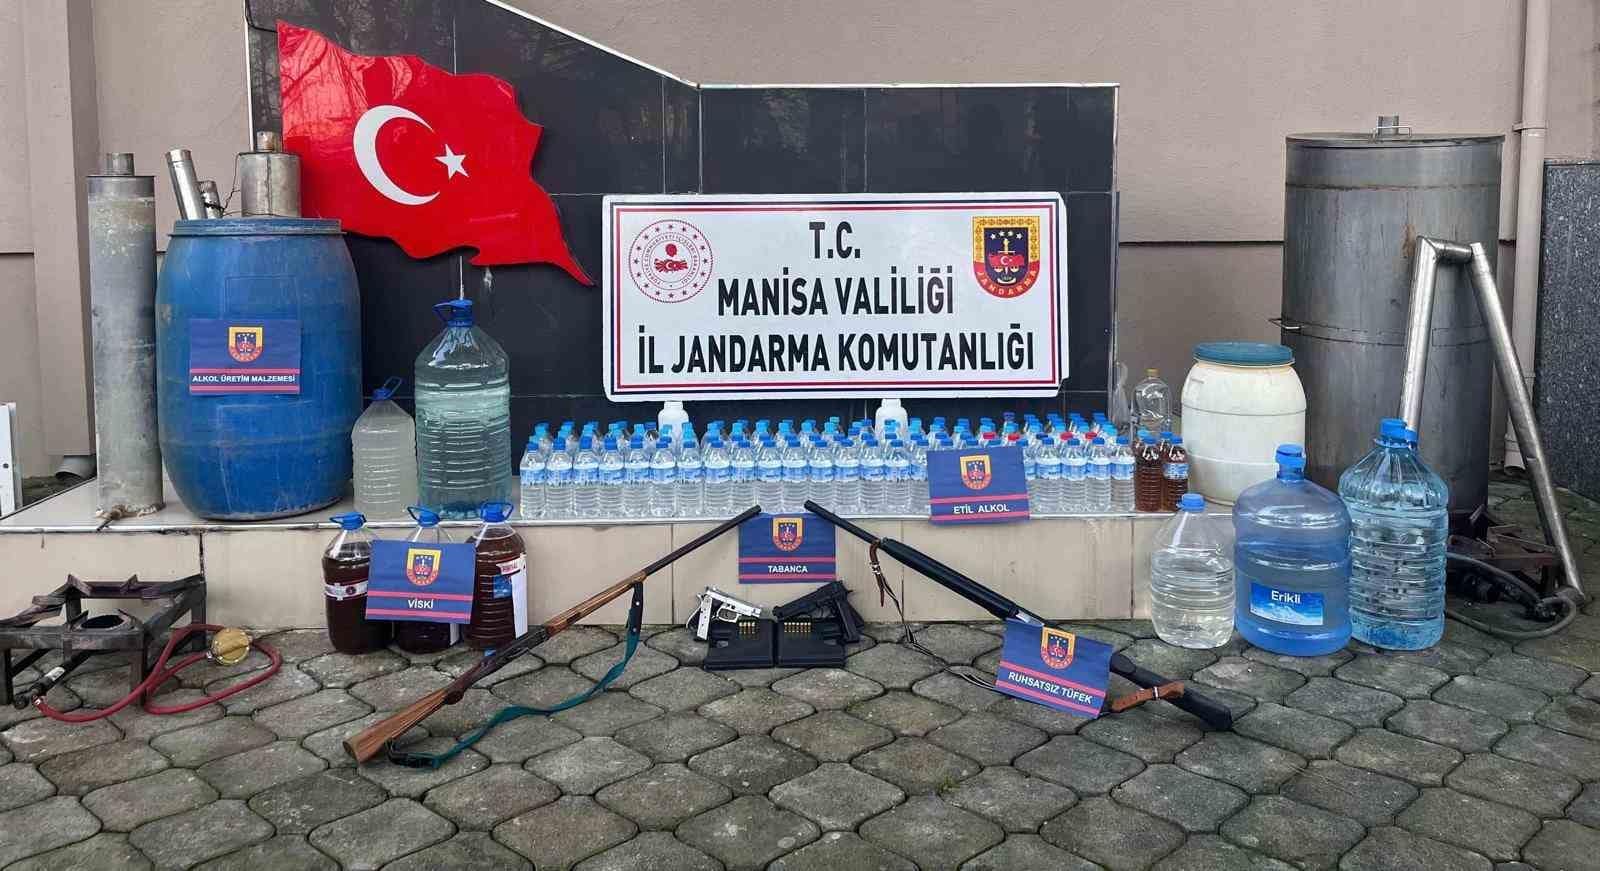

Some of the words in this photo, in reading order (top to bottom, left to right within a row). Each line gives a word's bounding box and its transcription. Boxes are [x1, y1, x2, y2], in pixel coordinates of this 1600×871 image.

[808, 222, 861, 259] T.C.
[717, 266, 825, 316] MANİSA
[834, 265, 953, 315] VALİLİĞİ
[638, 325, 664, 374] İL
[671, 333, 830, 373] JANDARMA
[838, 323, 1034, 372] KOMUTANLIĞI
[192, 375, 219, 383] ALKOL
[220, 374, 249, 383] ÜRETİM
[251, 374, 296, 383] MALZEMESİ
[953, 503, 974, 515] ETİL
[977, 503, 1010, 514] ALKOL
[767, 565, 808, 573] TABANCA
[407, 598, 434, 609] VİSKİ
[1271, 590, 1301, 604] Erikli
[1008, 671, 1060, 695] RUHSATSIZ
[1061, 687, 1093, 704] TÜFEK
